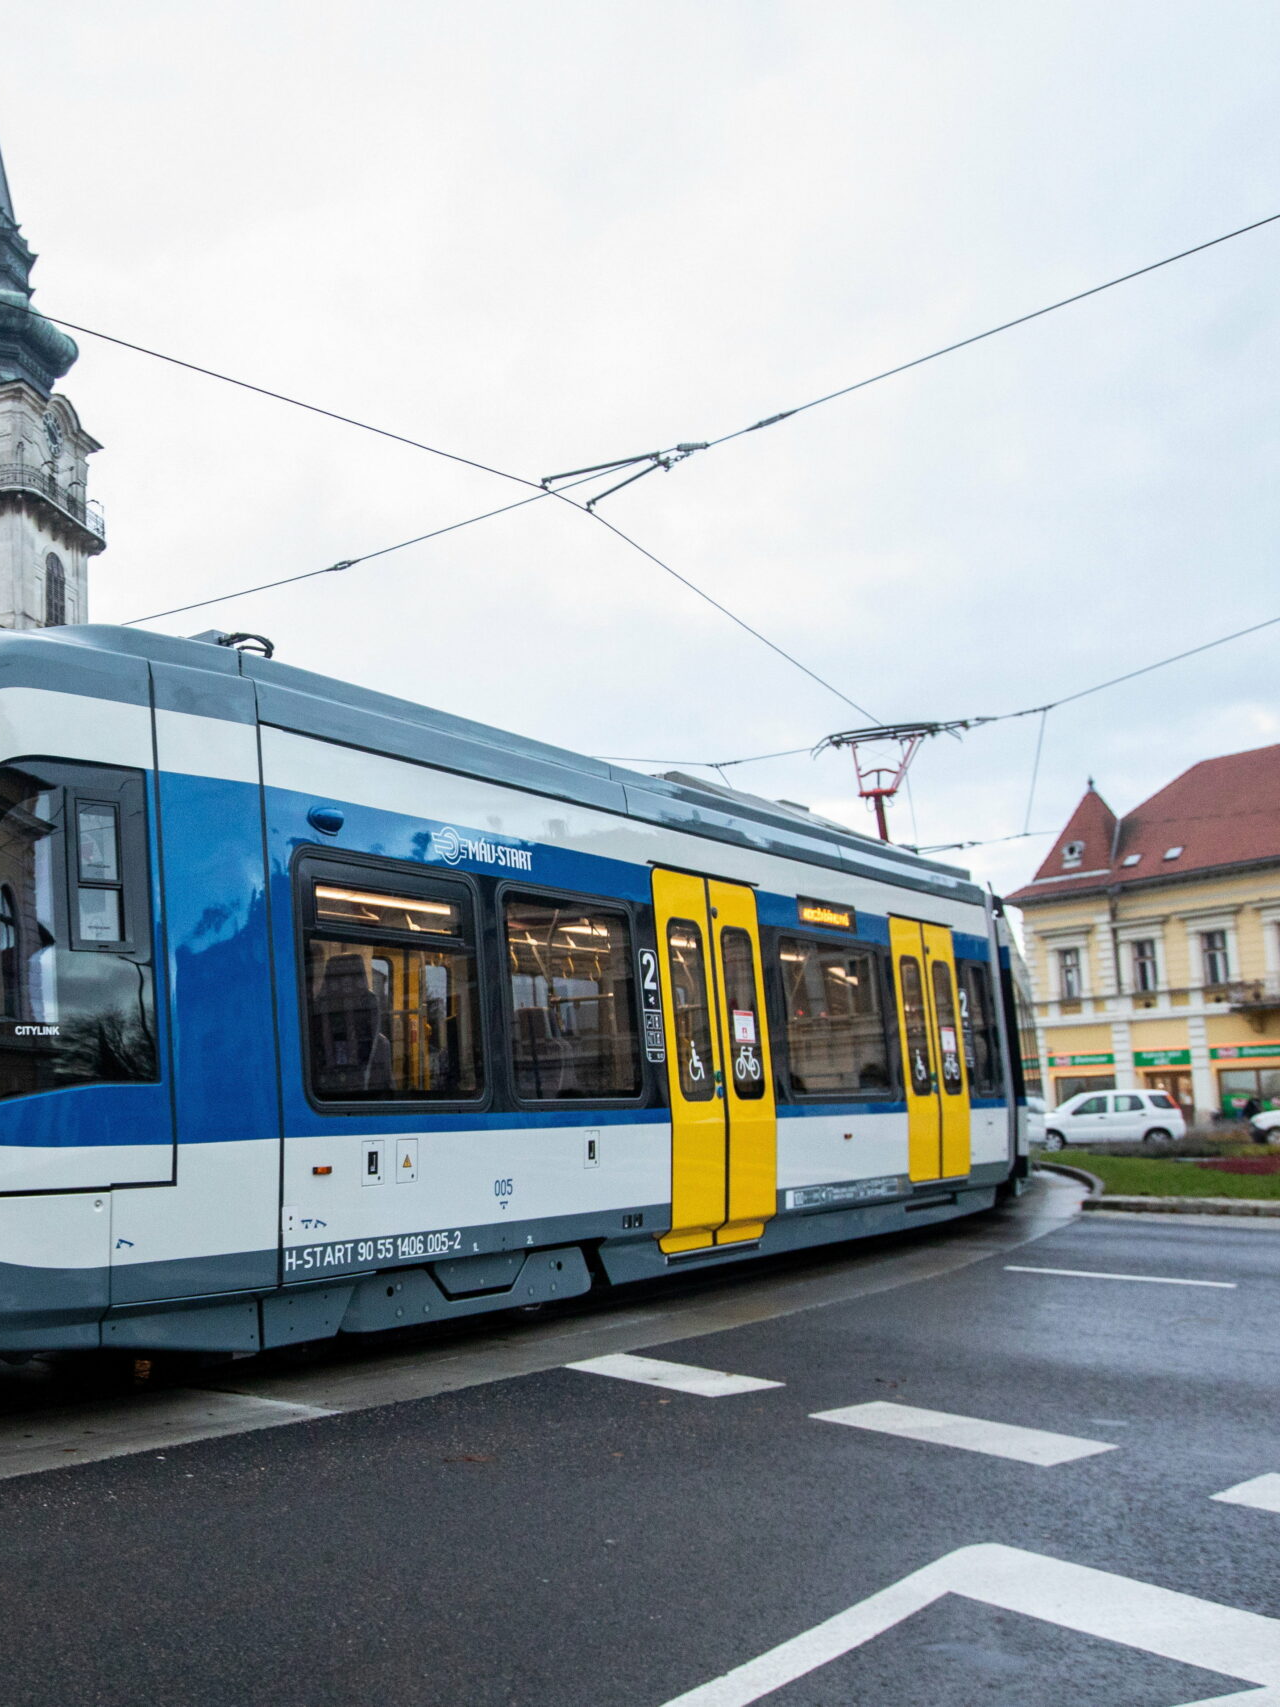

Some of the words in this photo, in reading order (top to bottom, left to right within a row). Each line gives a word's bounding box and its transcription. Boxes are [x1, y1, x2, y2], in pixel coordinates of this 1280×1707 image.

[642, 952, 658, 991] 2
[14, 1025, 60, 1036] CITYLINK
[494, 1178, 514, 1197] 005
[284, 1242, 355, 1272] H-START
[357, 1240, 375, 1263] 90
[376, 1237, 394, 1260] 55
[396, 1234, 424, 1258] 1406
[427, 1230, 462, 1253] 005-2
